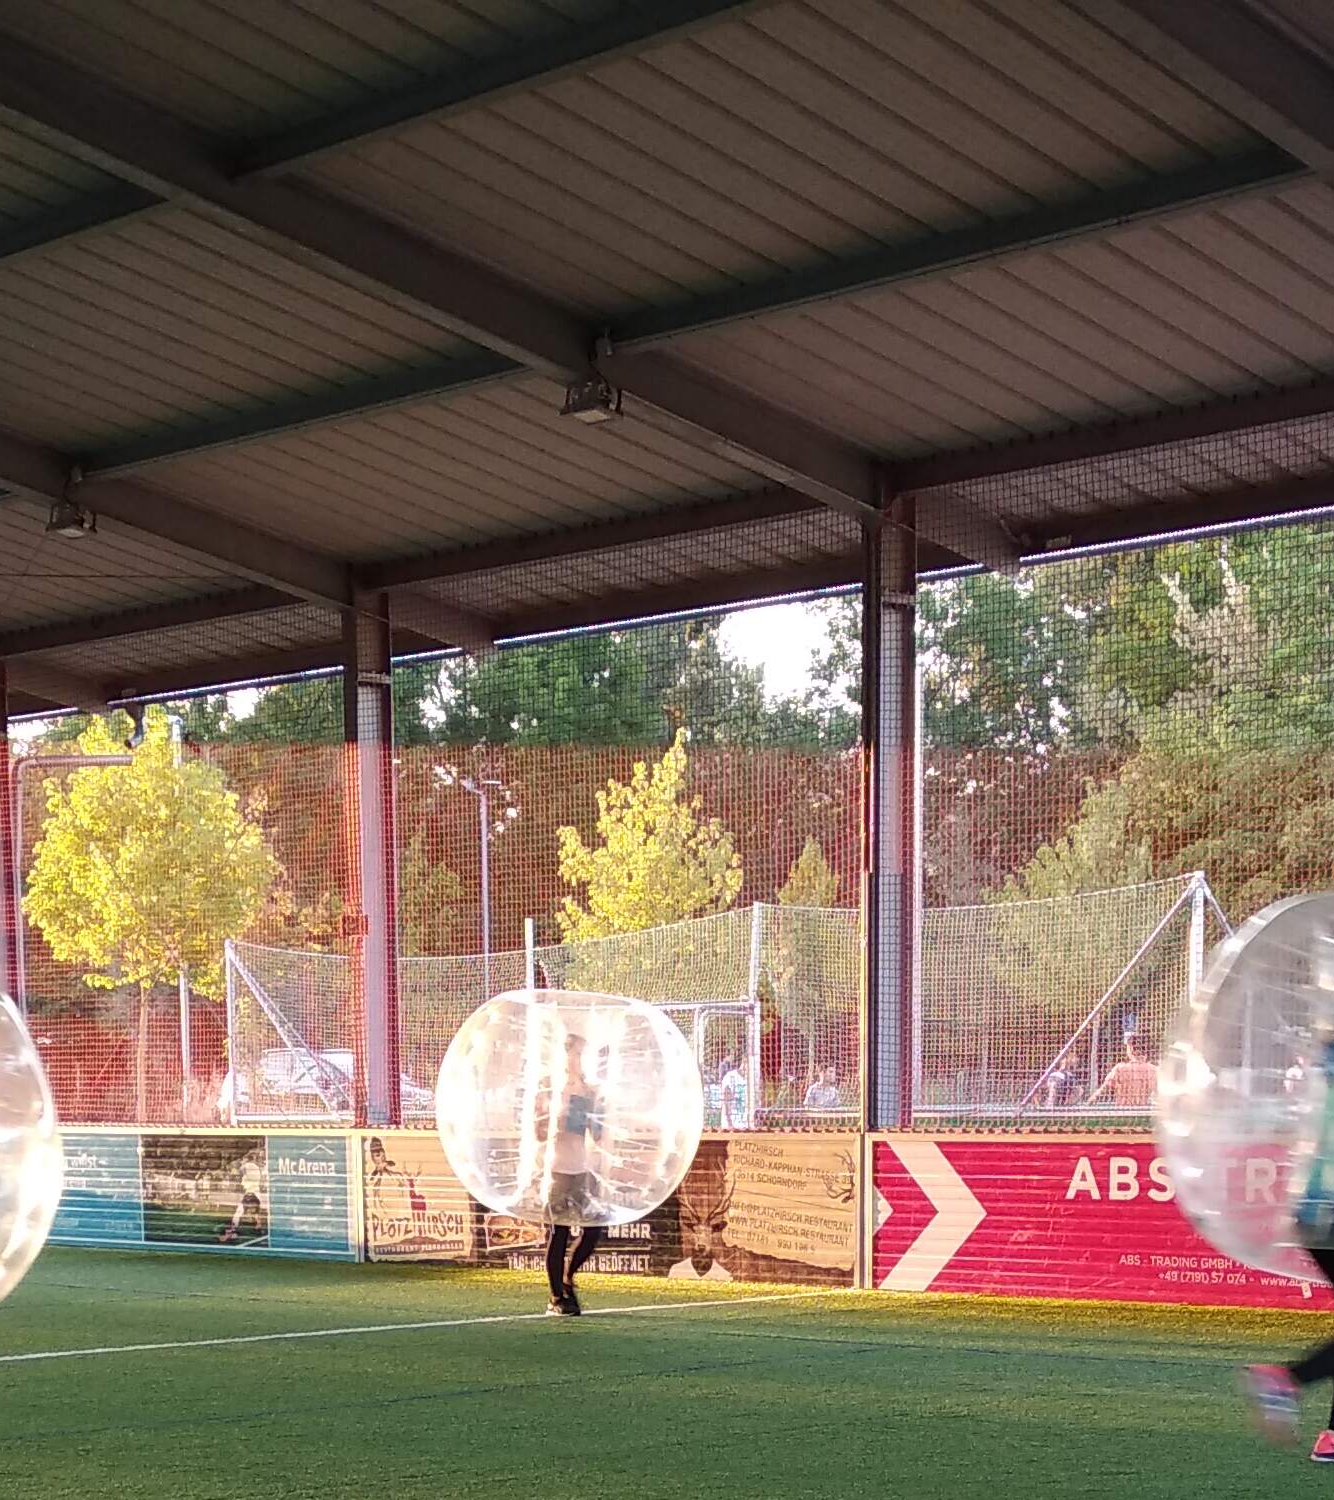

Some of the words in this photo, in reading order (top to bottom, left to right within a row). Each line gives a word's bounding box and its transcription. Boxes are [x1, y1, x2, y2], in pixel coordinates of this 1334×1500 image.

[1064, 1156, 1175, 1202] ABS
[598, 1252, 651, 1273] GEÖFFNET
[1119, 1254, 1141, 1266] ABS
[1149, 1255, 1198, 1268] TRADING
[1200, 1258, 1234, 1270] GMBH
